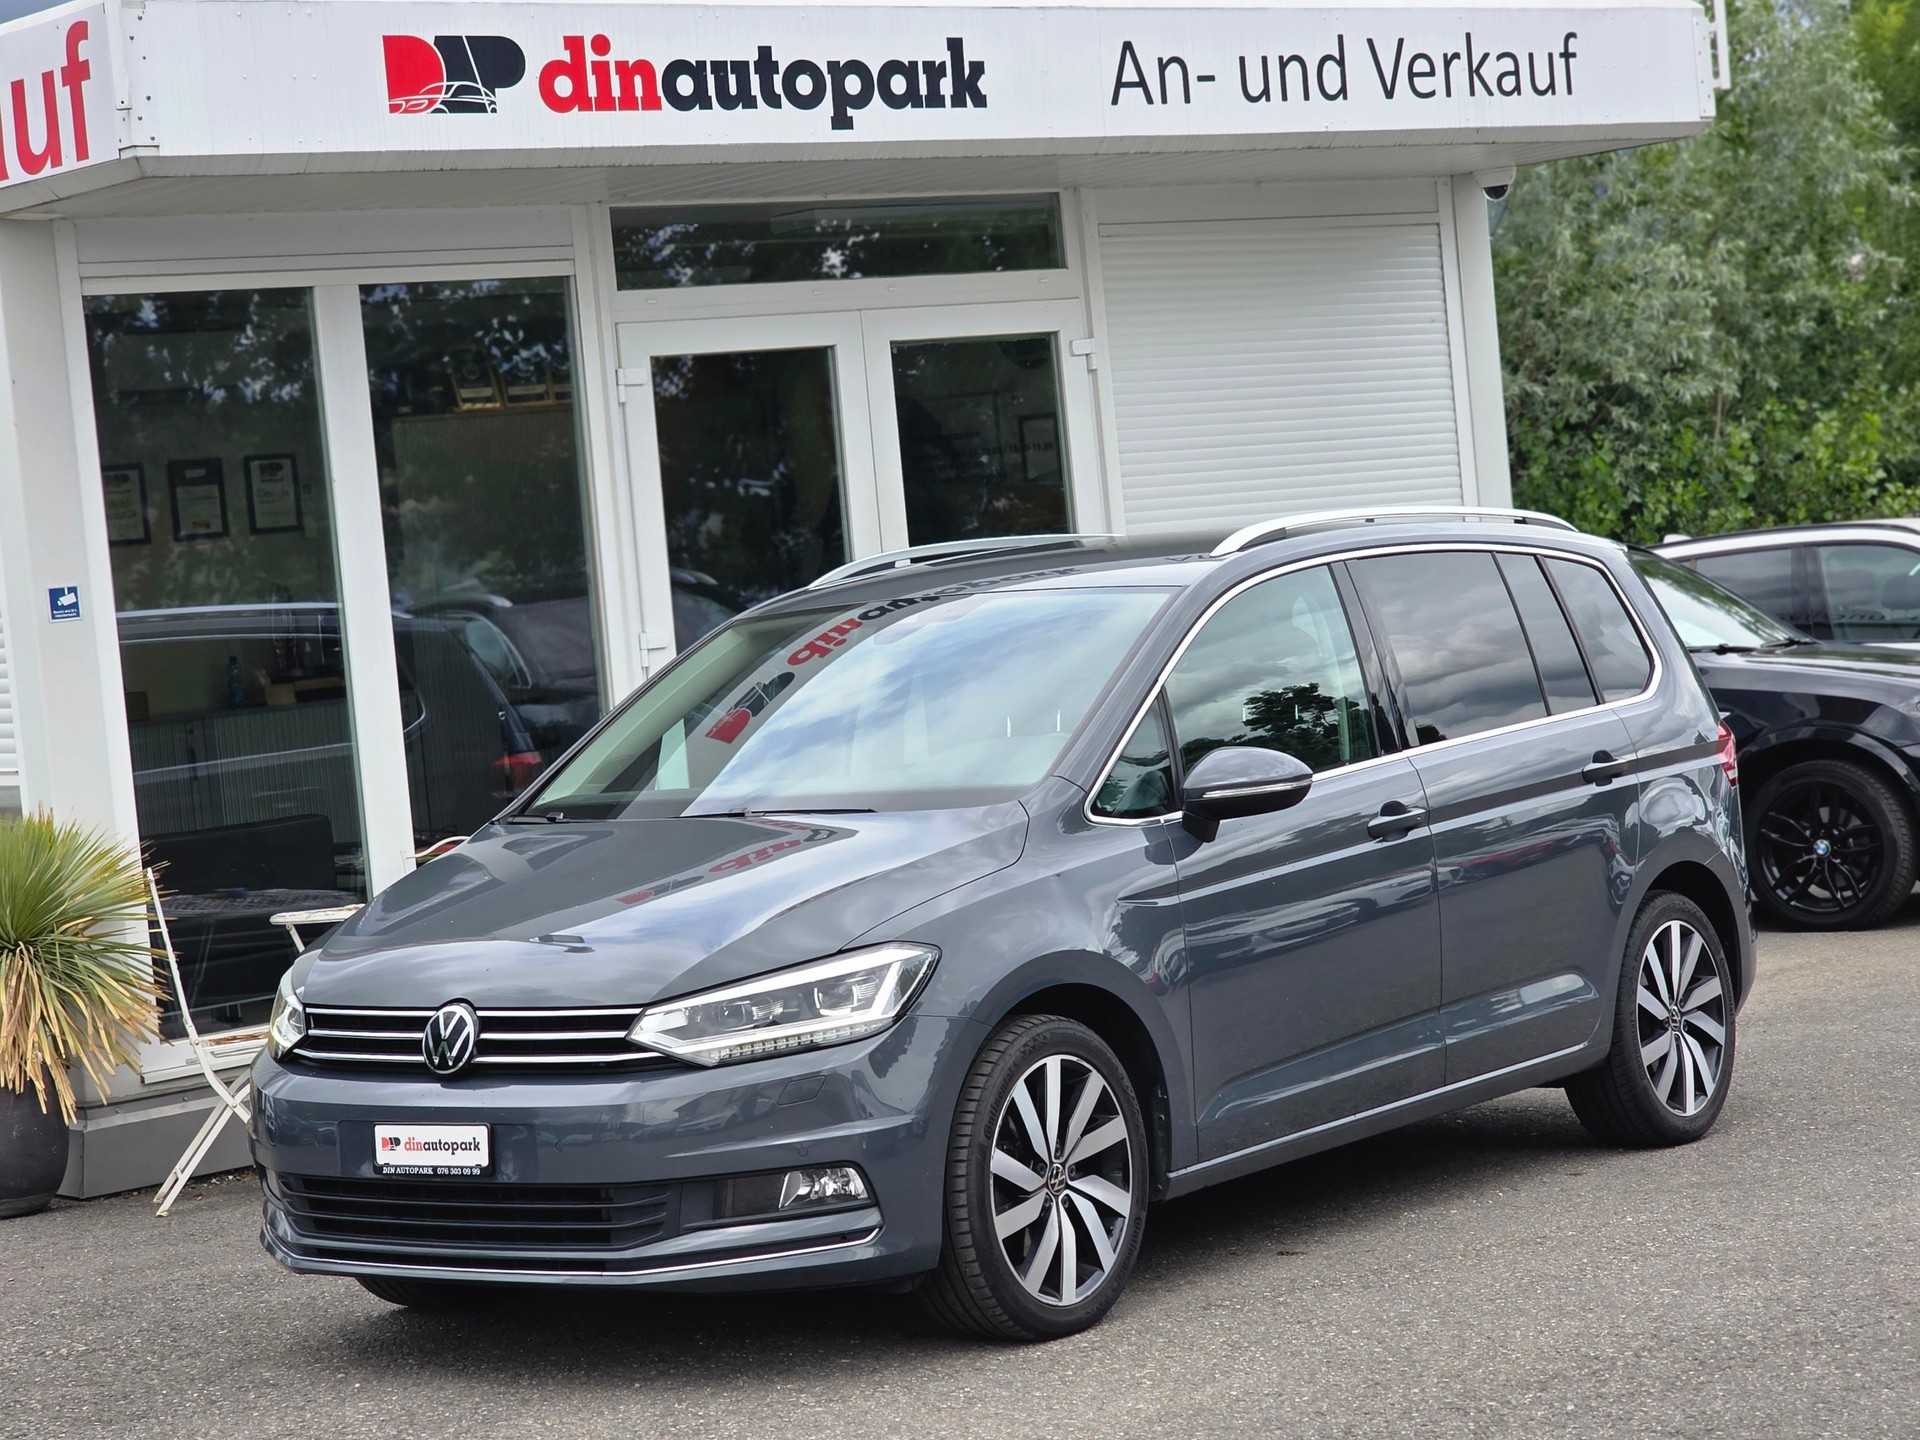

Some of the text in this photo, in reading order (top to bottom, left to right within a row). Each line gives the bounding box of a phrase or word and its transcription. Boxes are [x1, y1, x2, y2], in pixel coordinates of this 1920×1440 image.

[0, 20, 91, 181] uf
[538, 33, 988, 131] dinautopark
[1111, 31, 1578, 105] An- und Verkauf
[404, 1137, 480, 1155] dinautopark
[437, 1167, 449, 1175] 076
[450, 1167, 462, 1175] 303
[463, 1168, 471, 1176] 09
[472, 1168, 480, 1176] 99
